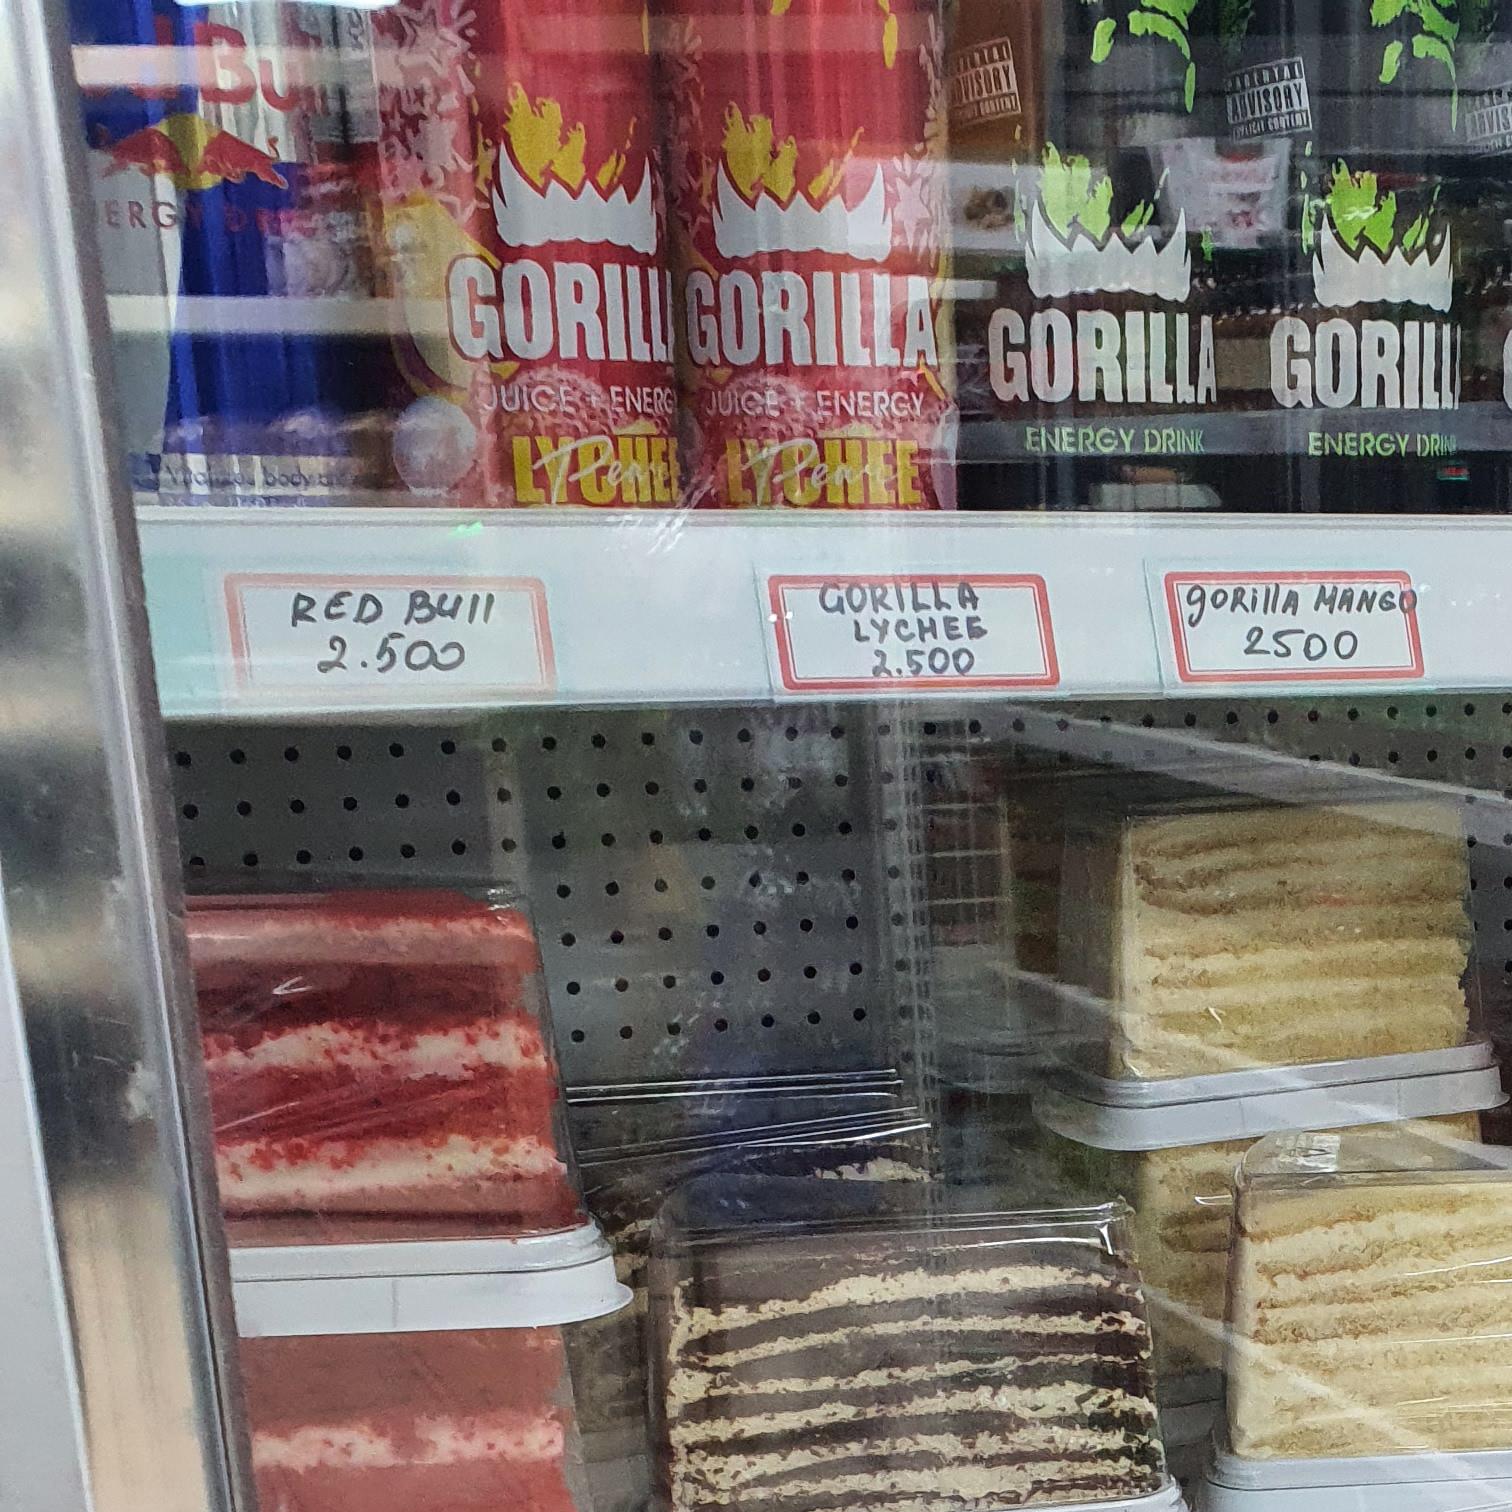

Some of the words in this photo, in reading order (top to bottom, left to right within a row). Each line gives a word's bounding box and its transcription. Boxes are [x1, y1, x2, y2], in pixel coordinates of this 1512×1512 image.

[687, 269, 939, 367] GORILLA
[988, 307, 1217, 405] GORILLA
[1270, 315, 1462, 411] GORILL
[482, 384, 575, 415] JUICE
[609, 385, 677, 417] ENERG
[705, 389, 779, 419] JUICE
[816, 389, 924, 418] ENERGY
[1025, 425, 1135, 454] ENERGY
[1143, 427, 1205, 454] DRINK
[1307, 431, 1408, 458] ENERGY
[291, 591, 383, 628] RED
[818, 581, 980, 615] GORILLA
[1312, 584, 1418, 616] MANGO
[853, 615, 989, 644] LYCHEE
[1243, 626, 1359, 662] 2500
[316, 631, 466, 674] 2.500
[871, 647, 976, 678] 2.500
